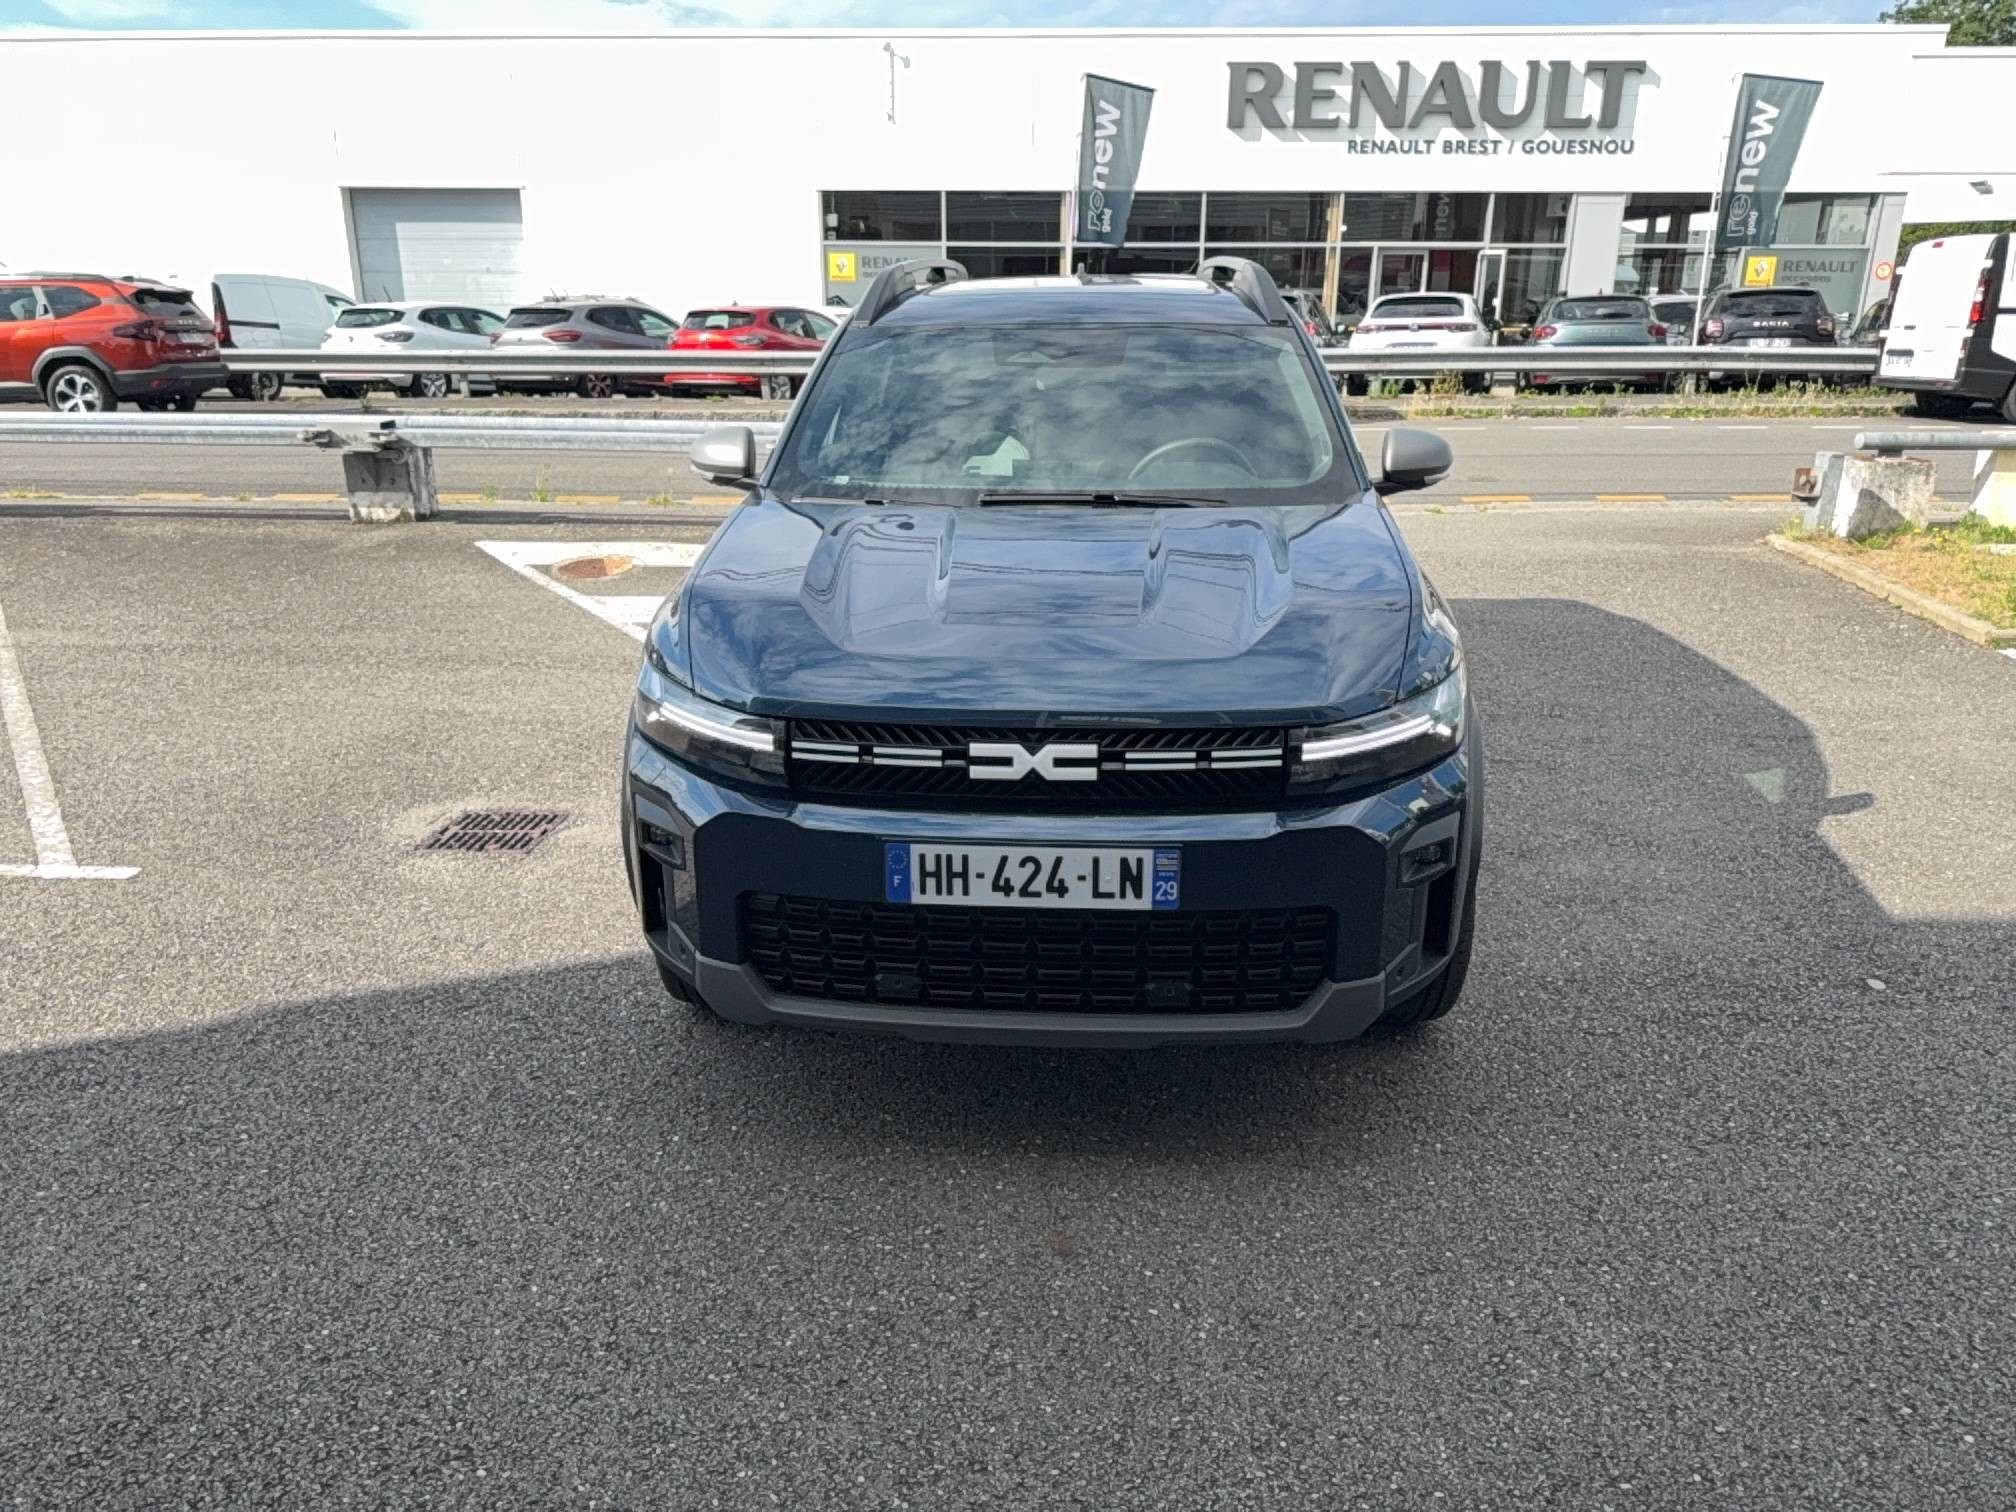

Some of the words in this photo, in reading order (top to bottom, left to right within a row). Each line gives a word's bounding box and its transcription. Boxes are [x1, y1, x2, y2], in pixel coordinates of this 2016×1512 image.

[1226, 60, 1647, 129] RENAULT
[1347, 139, 1434, 155] RENAULT
[1442, 139, 1502, 155] BREST
[1507, 140, 1515, 155] /
[1521, 139, 1635, 155] GOUESNOU
[1783, 259, 1858, 273] RENAULT
[894, 875, 903, 887] F
[918, 853, 1144, 900] HH-424-LN
[1155, 881, 1178, 901] 29
